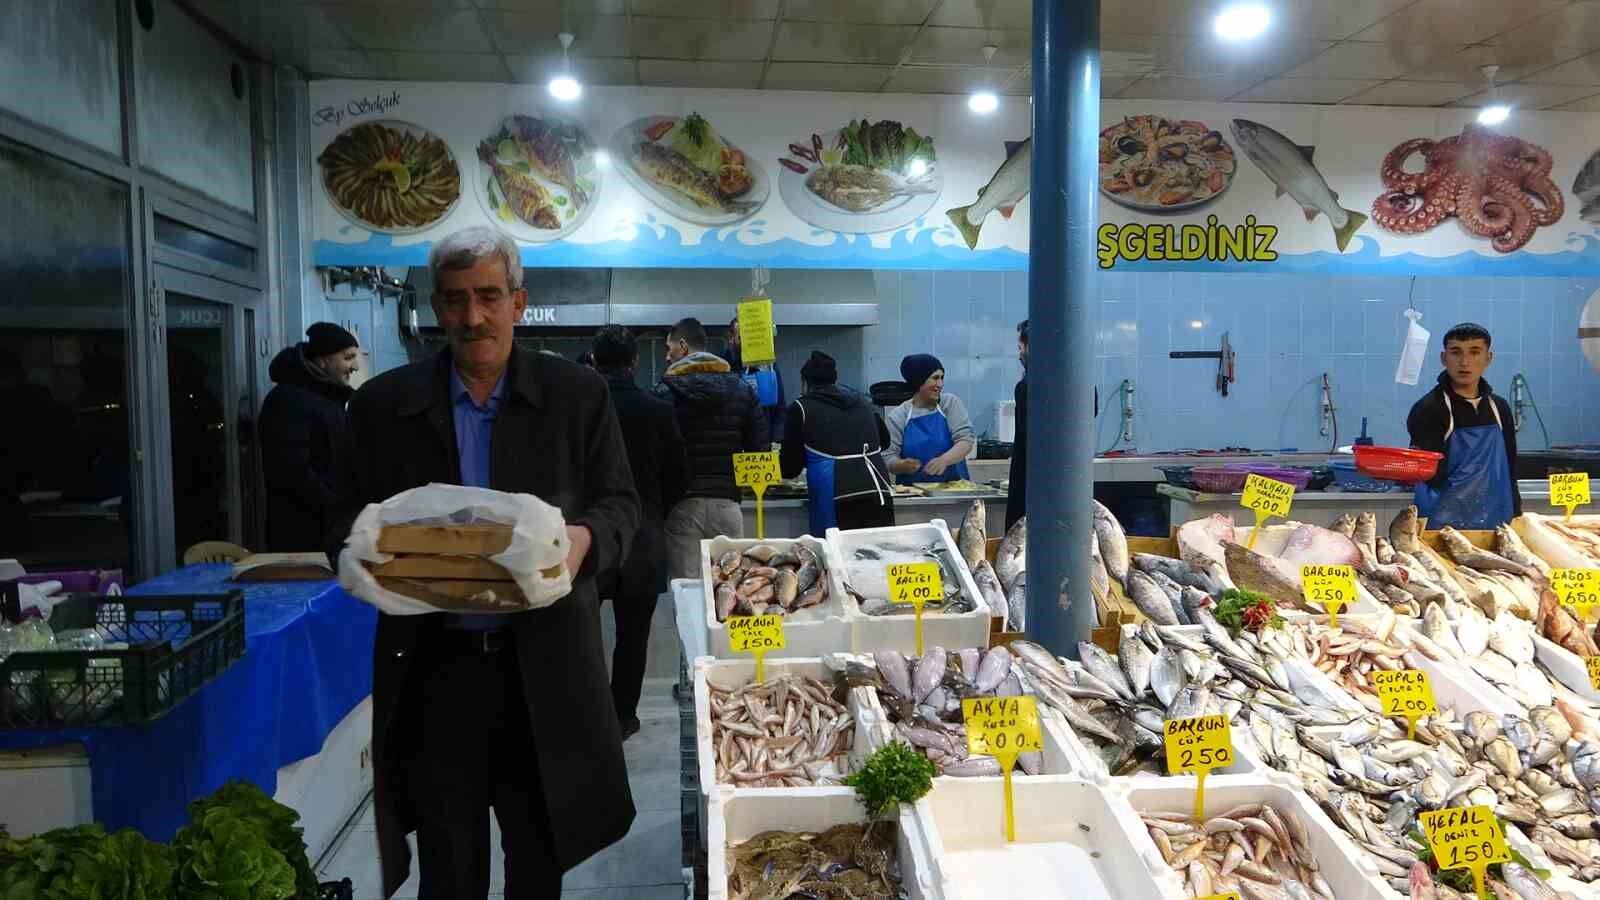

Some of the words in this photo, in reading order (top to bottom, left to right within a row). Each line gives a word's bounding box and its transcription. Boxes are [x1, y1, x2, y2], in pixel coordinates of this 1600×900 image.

[737, 454, 773, 463] SAZAN
[1304, 566, 1349, 577] BARBUN
[730, 617, 774, 630] BARBUN
[973, 700, 1018, 716] AKYA
[1168, 717, 1224, 735] BARBUN
